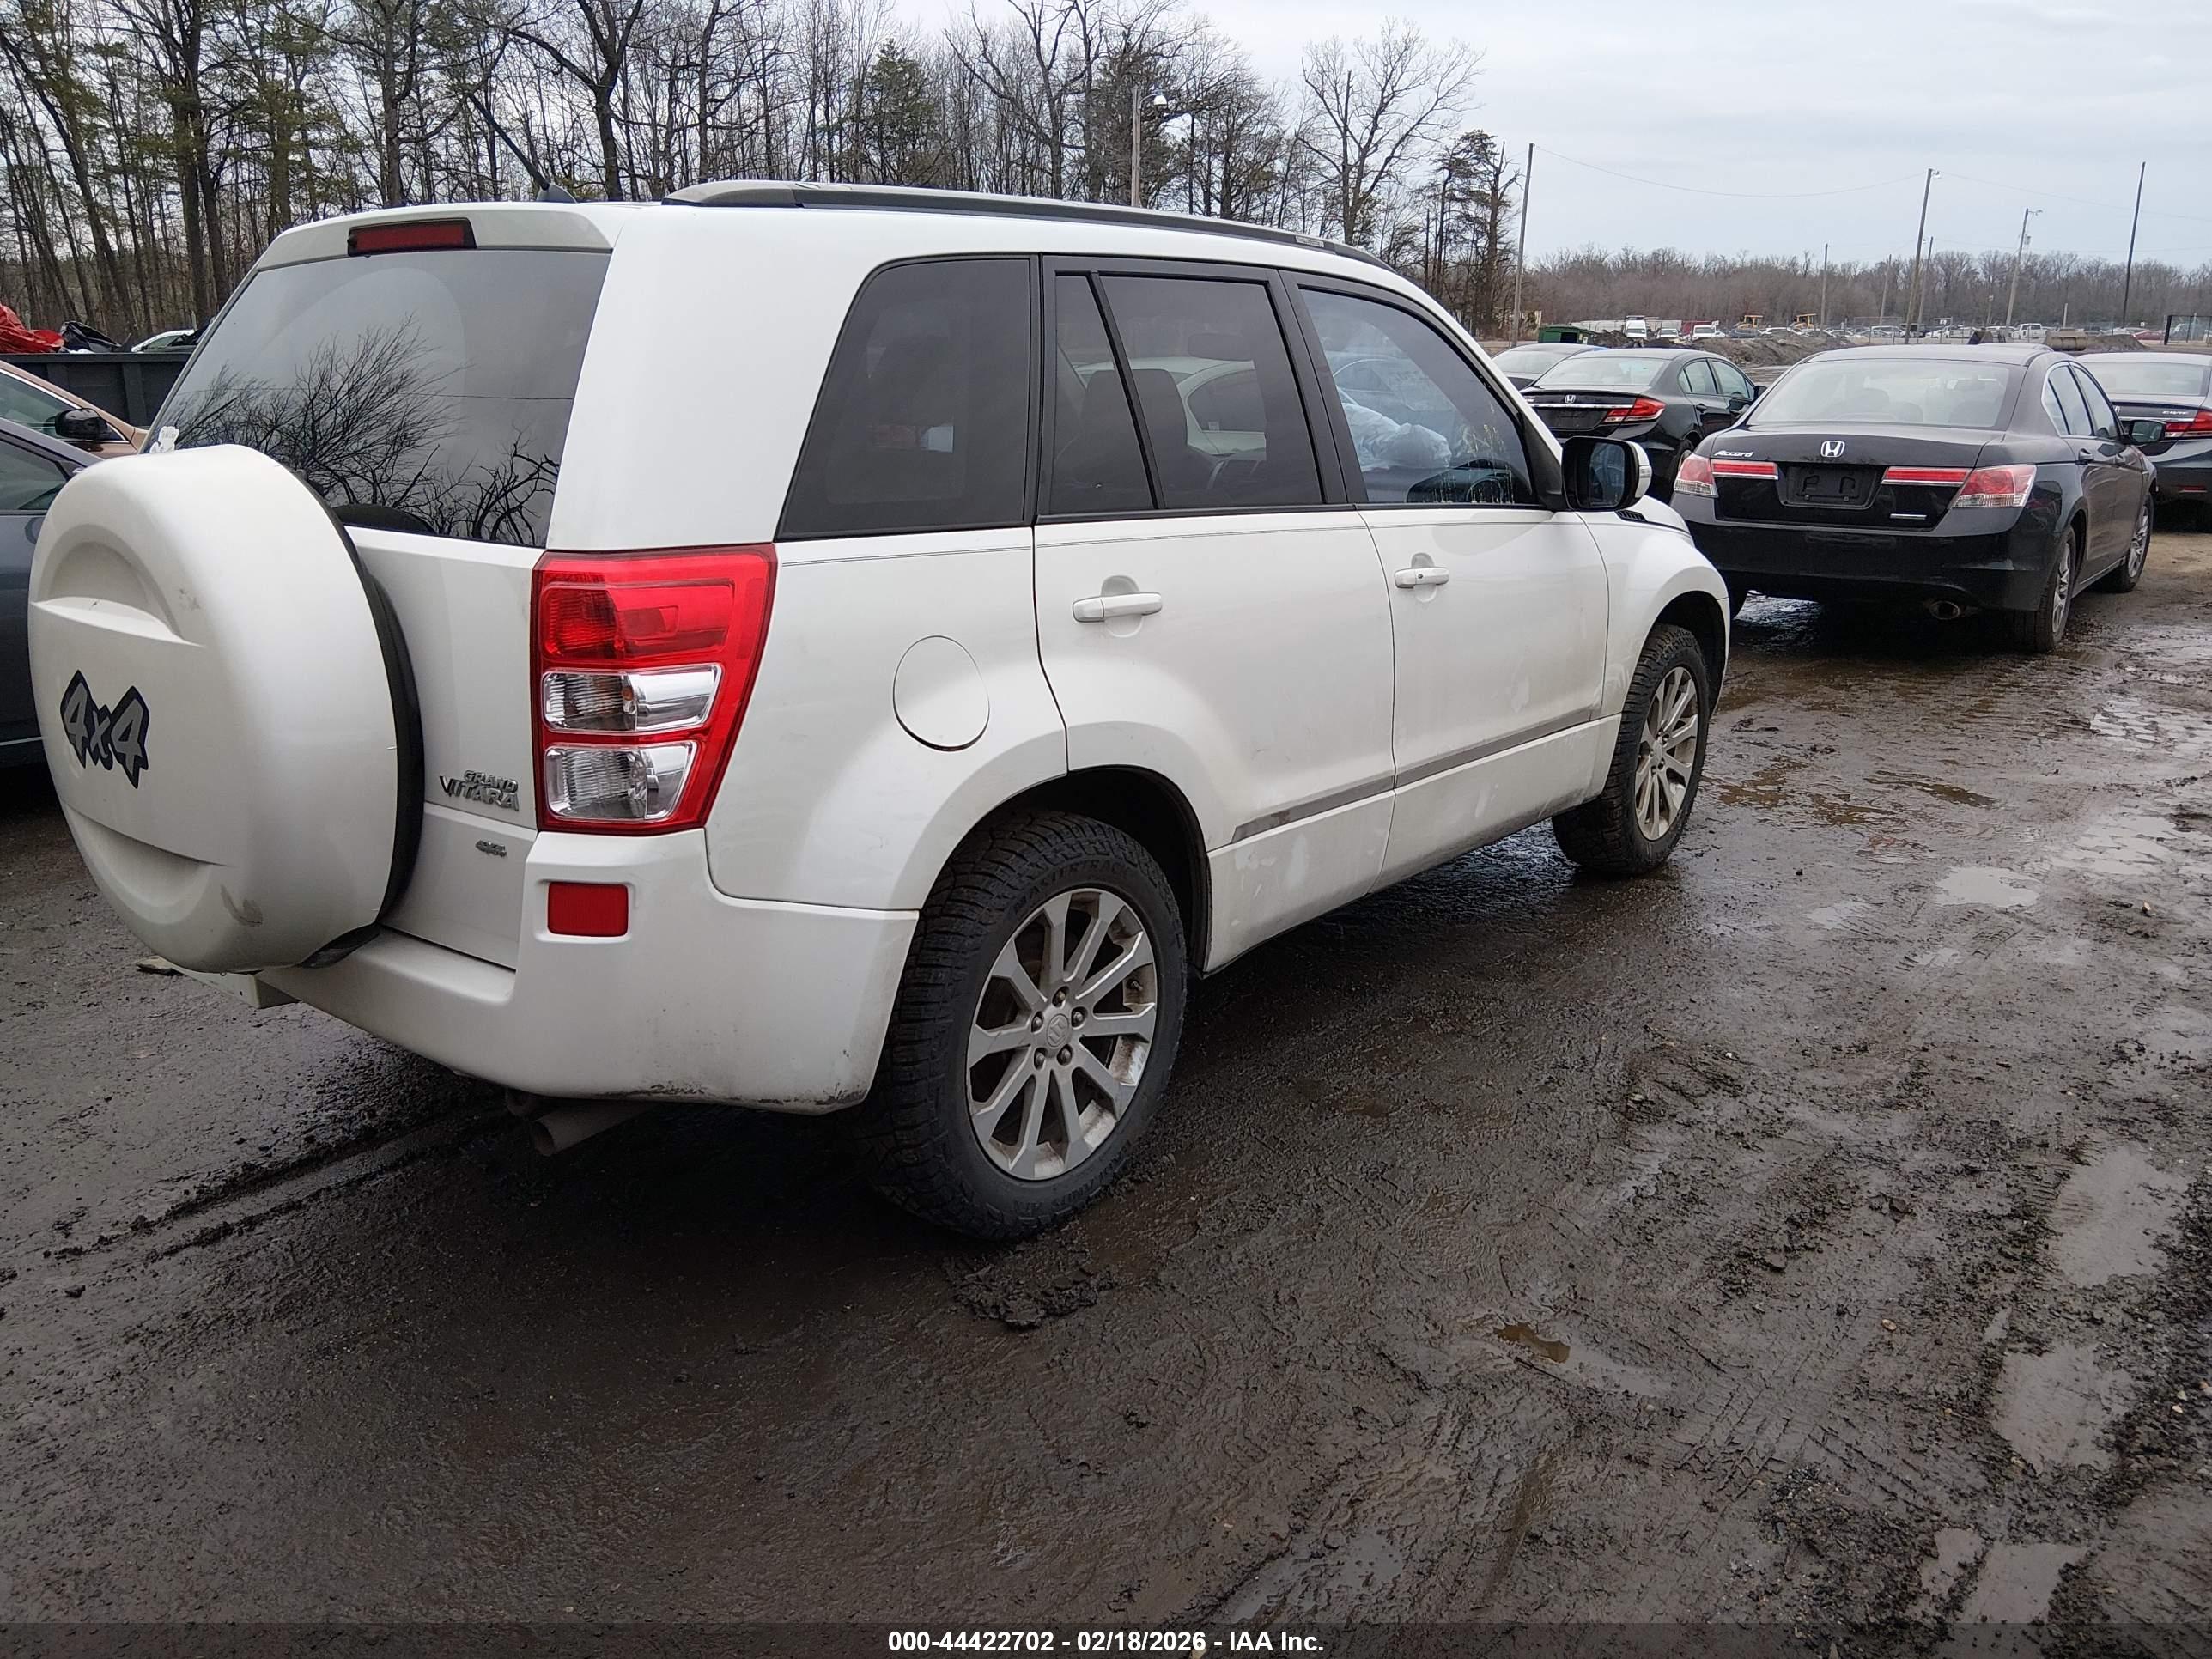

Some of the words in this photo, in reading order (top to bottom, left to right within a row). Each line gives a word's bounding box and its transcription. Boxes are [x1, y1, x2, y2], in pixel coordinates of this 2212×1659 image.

[60, 671, 149, 788] 4x4
[439, 775, 520, 811] VITARA
[464, 770, 519, 793] GRAND
